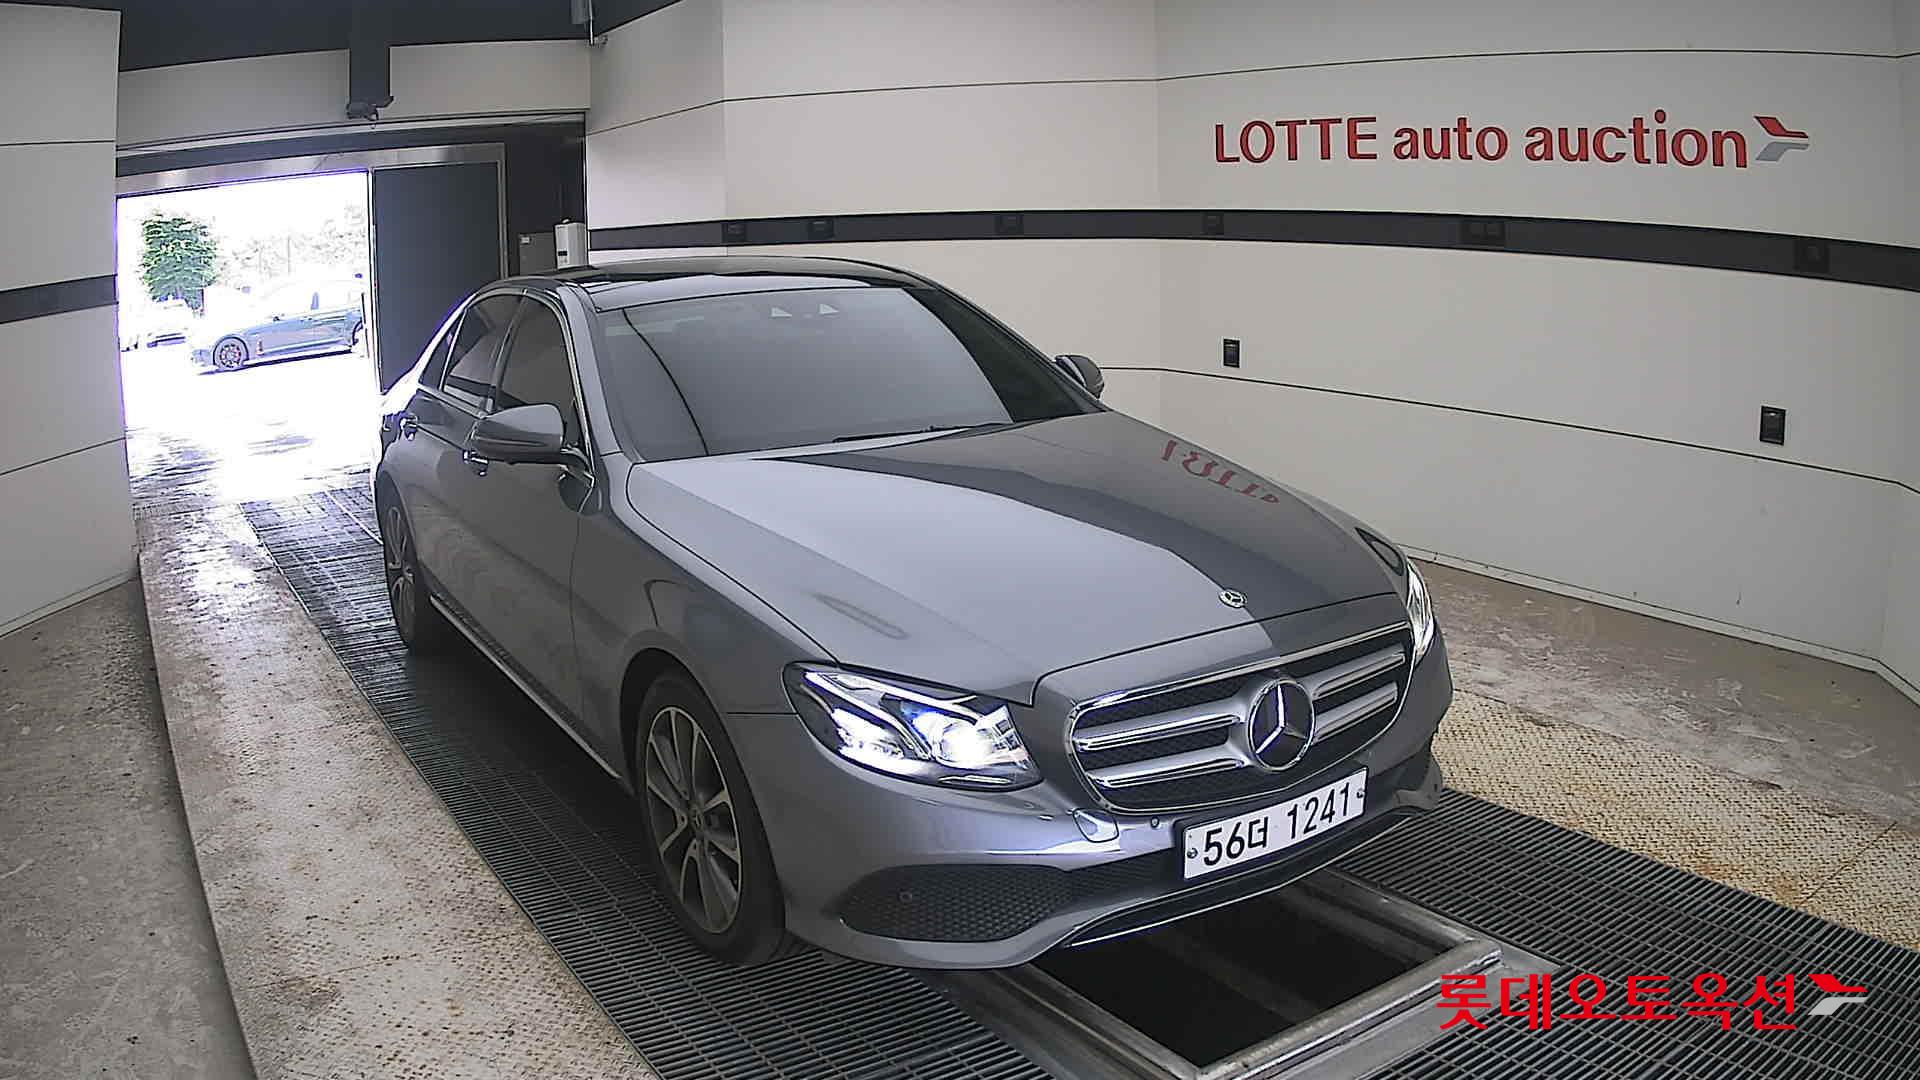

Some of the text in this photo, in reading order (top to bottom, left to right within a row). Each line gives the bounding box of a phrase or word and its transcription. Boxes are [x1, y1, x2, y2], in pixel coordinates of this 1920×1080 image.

[1215, 109, 1748, 168] LOTTE auto auction
[1203, 782, 1350, 866] 56더 1241
